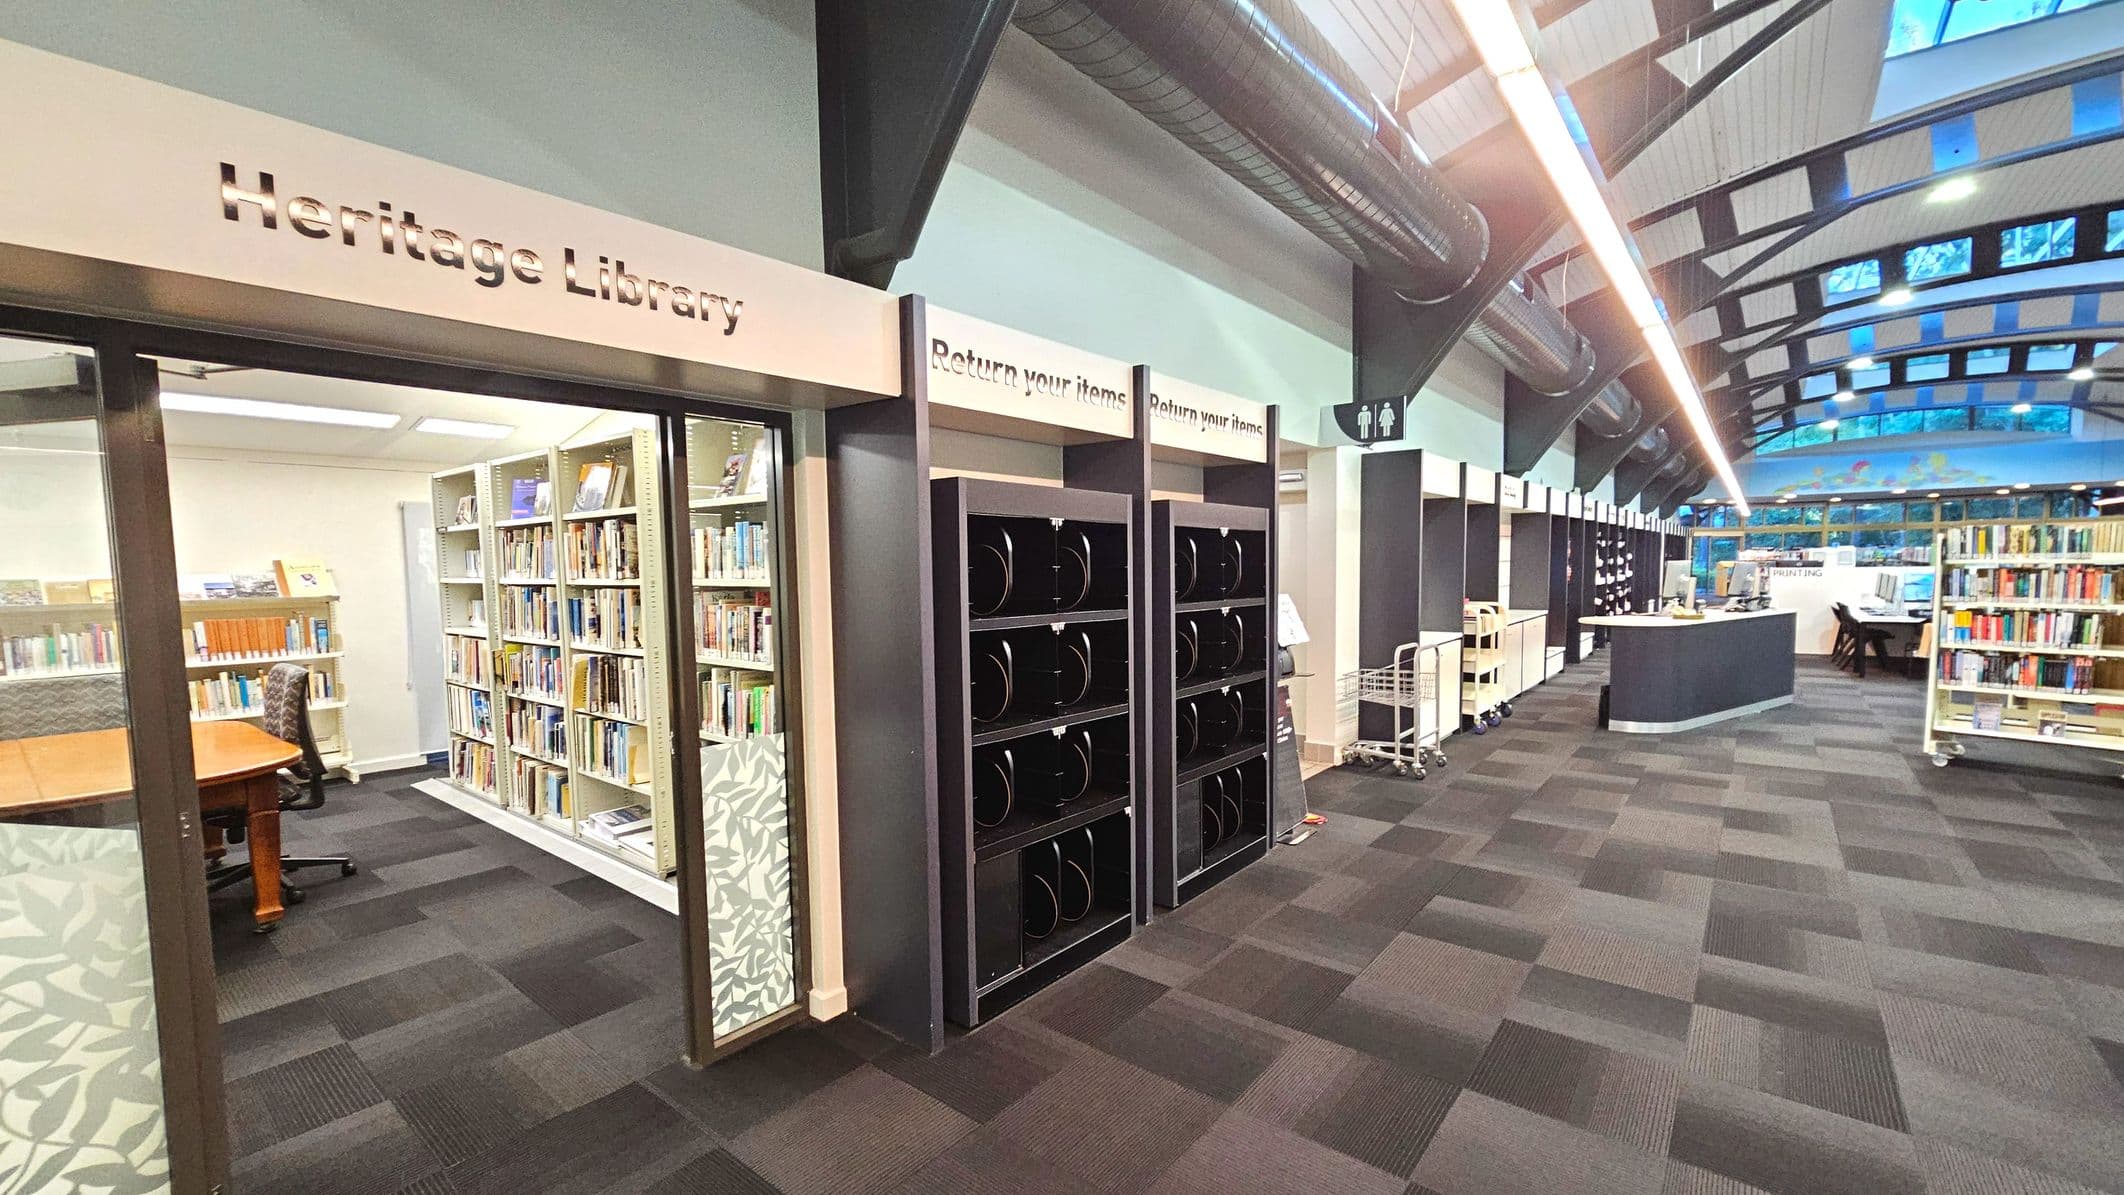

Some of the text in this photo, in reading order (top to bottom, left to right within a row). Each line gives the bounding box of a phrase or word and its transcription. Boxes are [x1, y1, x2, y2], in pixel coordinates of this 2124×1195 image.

[219, 161, 745, 336] Heritage Library
[932, 337, 1127, 412] Return your items
[1149, 392, 1264, 439] Return your items
[1773, 569, 1823, 577] PRINTING
